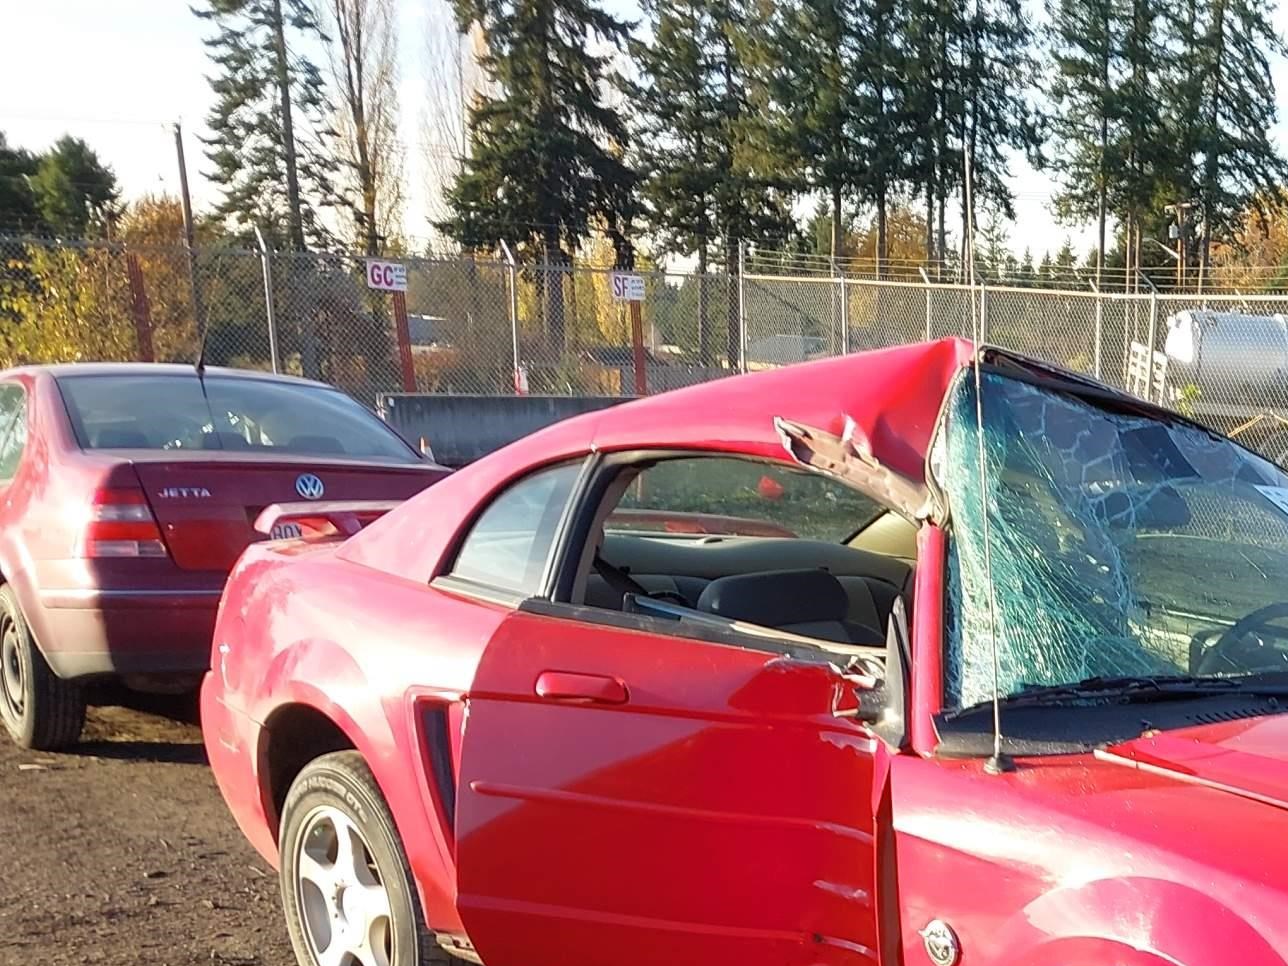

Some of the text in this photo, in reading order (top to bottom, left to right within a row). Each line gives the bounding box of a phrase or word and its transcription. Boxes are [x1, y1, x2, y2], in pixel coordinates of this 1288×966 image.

[371, 264, 394, 287] GC
[614, 276, 628, 297] SF
[158, 488, 211, 498] JETTA
